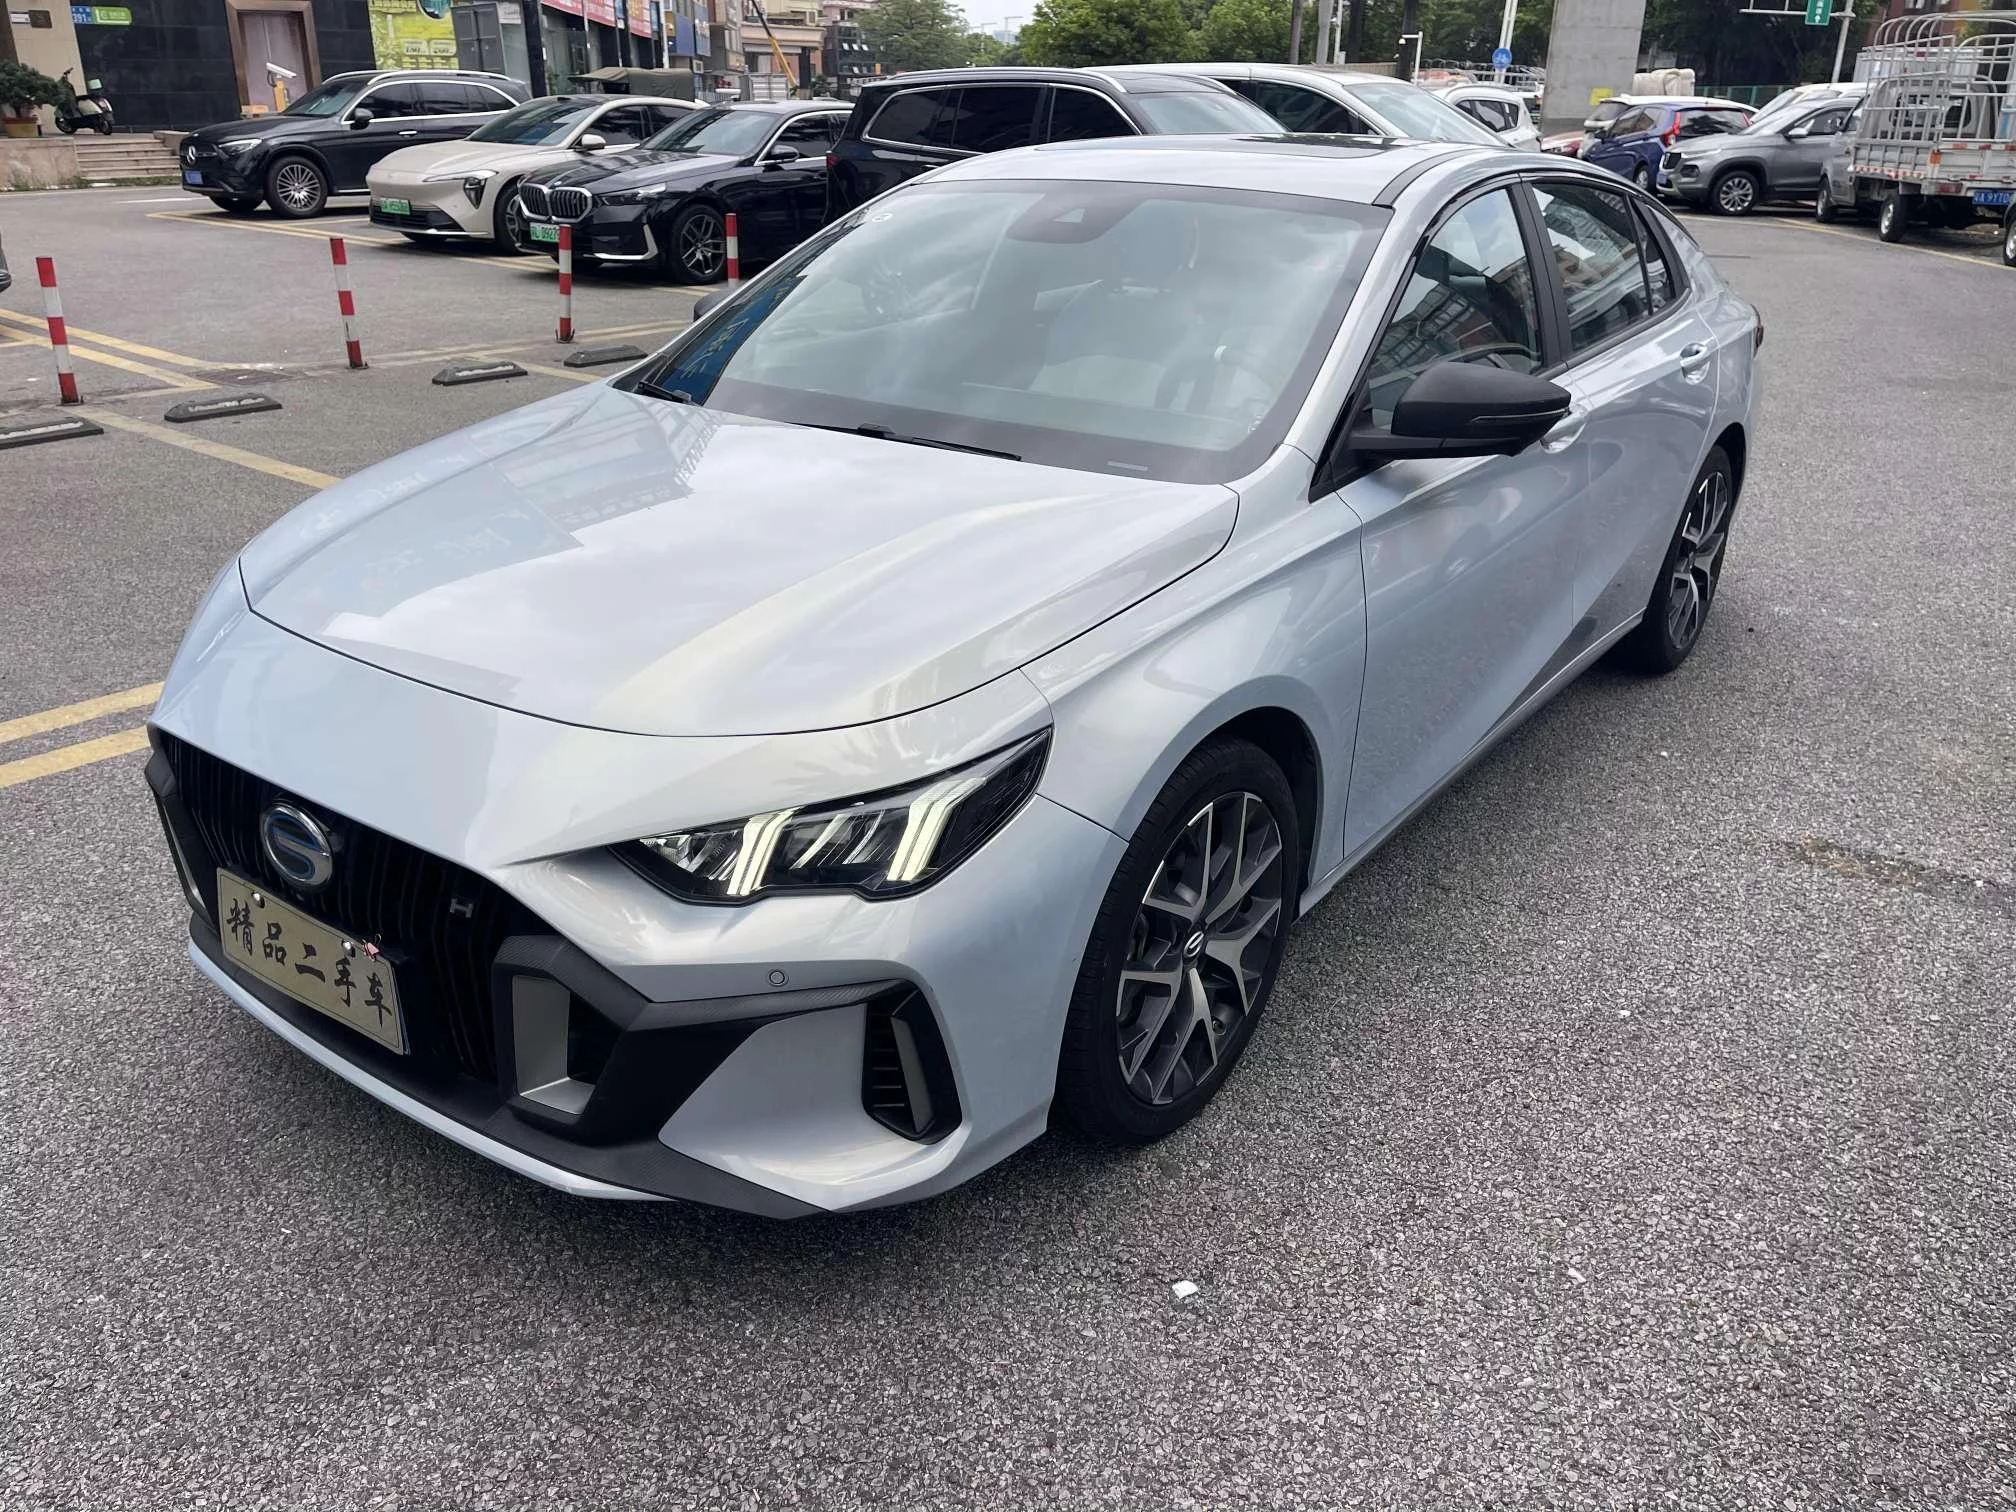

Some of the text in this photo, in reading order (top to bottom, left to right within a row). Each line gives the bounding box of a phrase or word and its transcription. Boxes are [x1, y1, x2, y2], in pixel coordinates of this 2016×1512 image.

[226, 897, 393, 1028] 精品二手车
